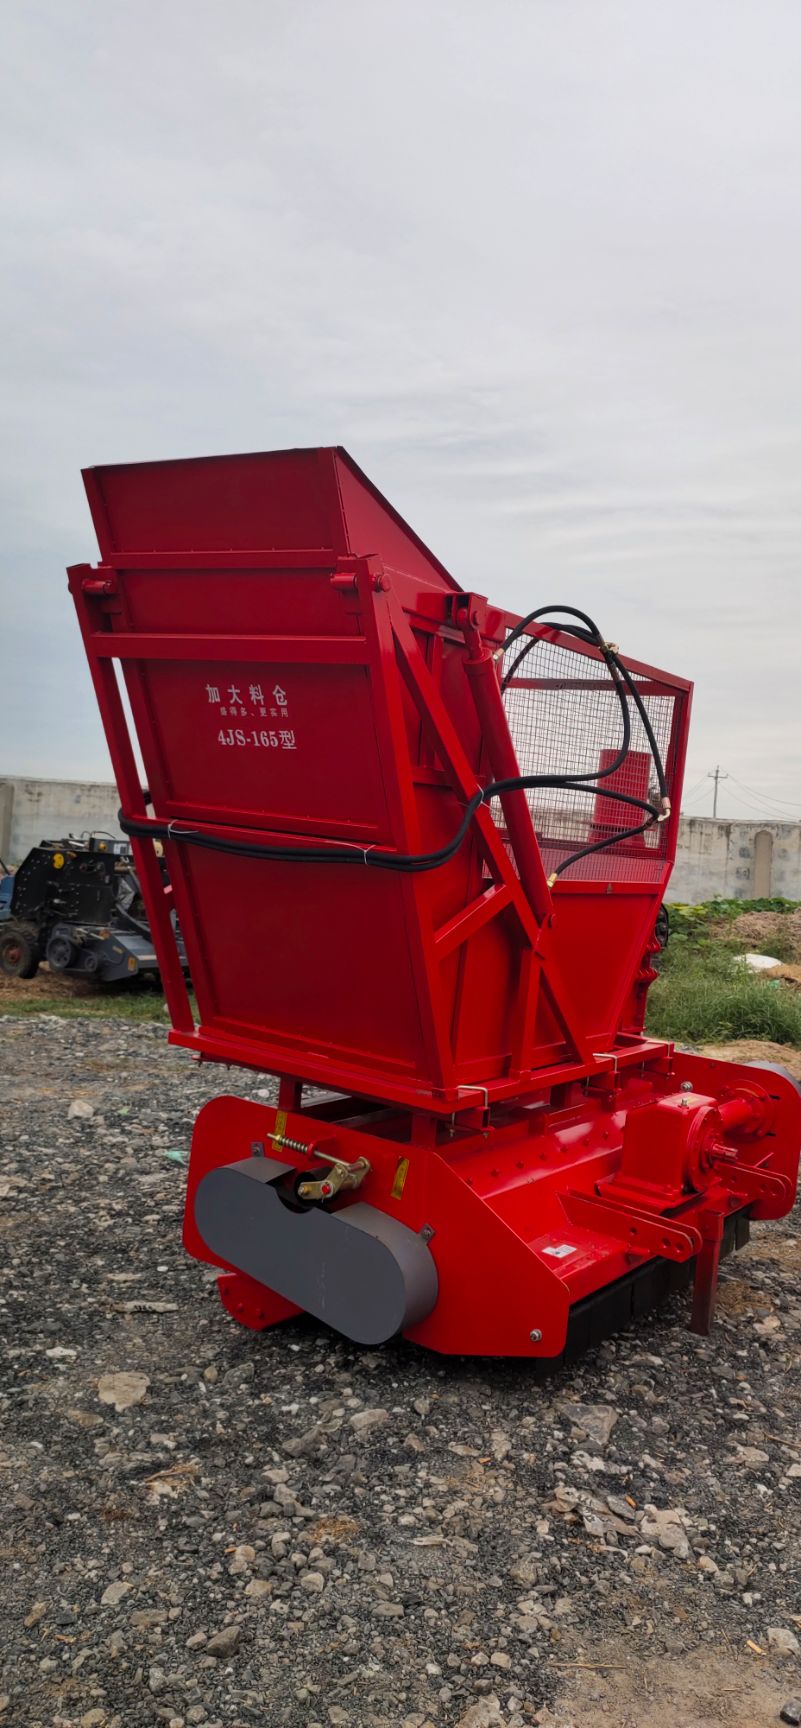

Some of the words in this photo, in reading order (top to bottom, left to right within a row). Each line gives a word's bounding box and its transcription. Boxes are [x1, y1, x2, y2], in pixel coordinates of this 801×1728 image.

[206, 684, 288, 705] 加大料仓
[218, 729, 297, 749] 4JS-165型
